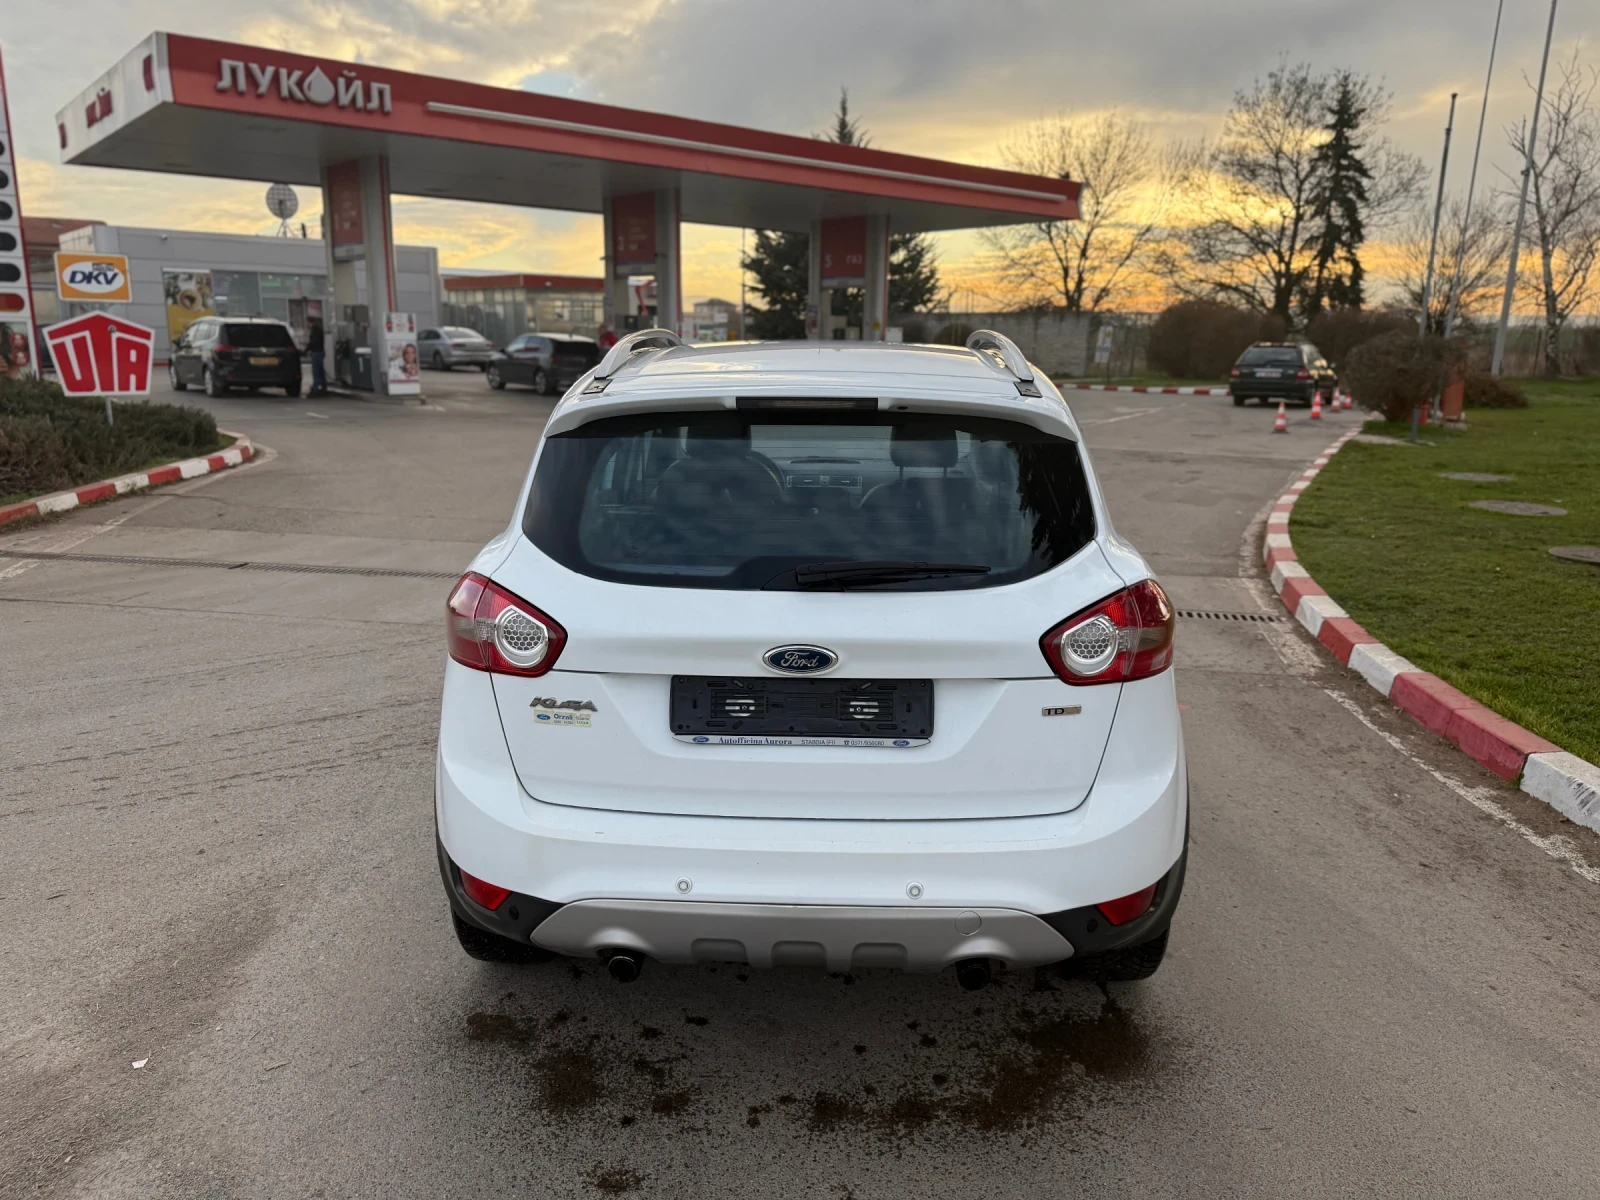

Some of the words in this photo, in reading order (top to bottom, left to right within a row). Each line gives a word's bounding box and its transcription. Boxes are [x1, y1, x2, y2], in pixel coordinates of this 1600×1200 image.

[215, 58, 392, 115] ЛУКОЙЛ
[69, 270, 119, 285] DKV
[47, 314, 151, 392] UTA
[780, 651, 820, 667] Ford
[718, 736, 763, 745] Autofficina
[764, 737, 793, 745] Aurora
